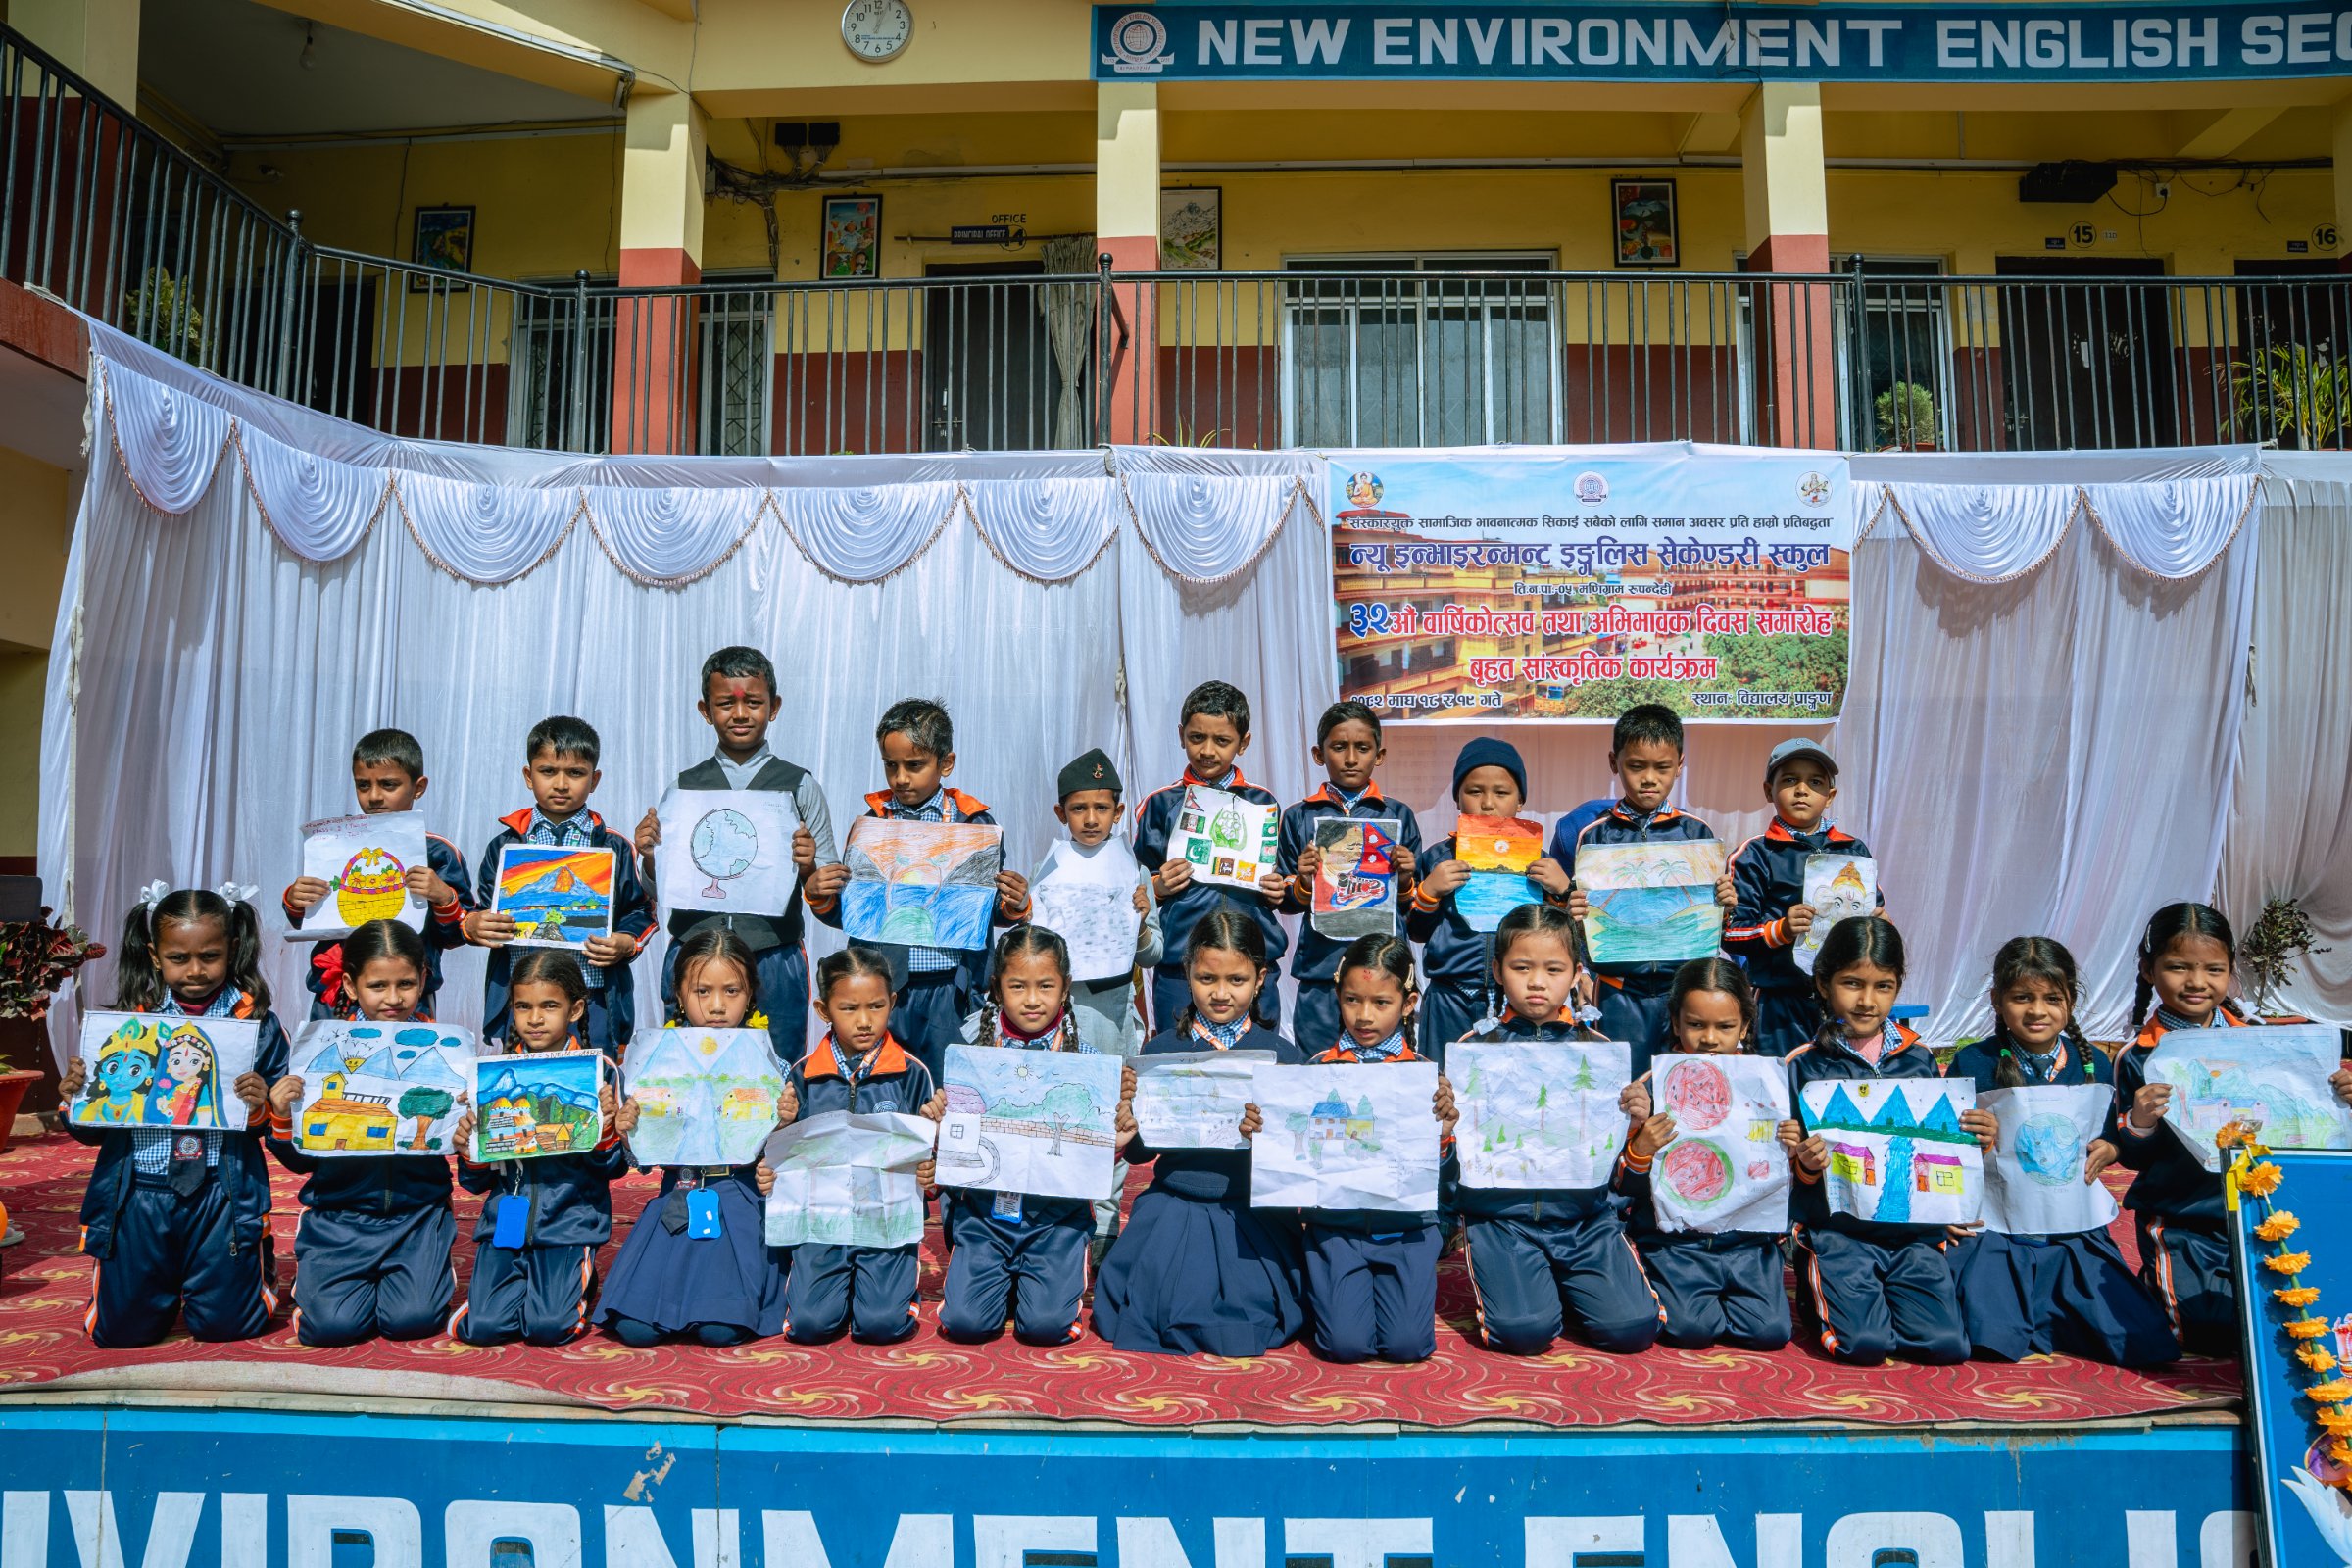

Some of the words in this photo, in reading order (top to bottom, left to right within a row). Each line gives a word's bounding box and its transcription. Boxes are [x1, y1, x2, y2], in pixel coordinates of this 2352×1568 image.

[1198, 19, 1351, 65] NEW
[1373, 18, 1902, 67] ENVIRONMENT
[1936, 18, 2218, 68] ENGLISH
[992, 213, 1027, 223] OFFICE
[2074, 225, 2093, 243] 15
[2316, 228, 2337, 245] 16
[1418, 515, 1472, 528] सामाजिक
[1476, 517, 1539, 528] भावनात्मक
[1542, 515, 1579, 528] सिकाई
[1583, 514, 1616, 528] सबैको
[1620, 514, 1648, 528] लागि
[1652, 517, 1685, 528] समान
[1689, 517, 1725, 528] अवसर
[1730, 514, 1749, 528] प्रति
[1753, 514, 1779, 529] हाम्रो
[1350, 543, 1391, 572] न्यू
[1394, 543, 1552, 569] इन्भाइरन्मन्ट
[1656, 536, 1760, 567] सेकेण्डरी
[1768, 543, 1831, 571] स्कुल
[1579, 582, 1624, 595] मणिग्राम
[1423, 604, 1535, 635] वार्षिकोत्सव
[1542, 612, 1582, 634] तथा
[1589, 604, 1690, 633] अभिभावक
[1696, 604, 1749, 635] दिवस
[1755, 606, 1832, 636] समारोह
[1470, 658, 1515, 686] बृहत
[1521, 651, 1622, 686] सांस्कृतिक
[1629, 653, 1717, 681] कार्यक्रम
[1387, 694, 1415, 707] माघ
[1480, 691, 1502, 707] गते
[1737, 690, 1791, 705] विद्यालय
